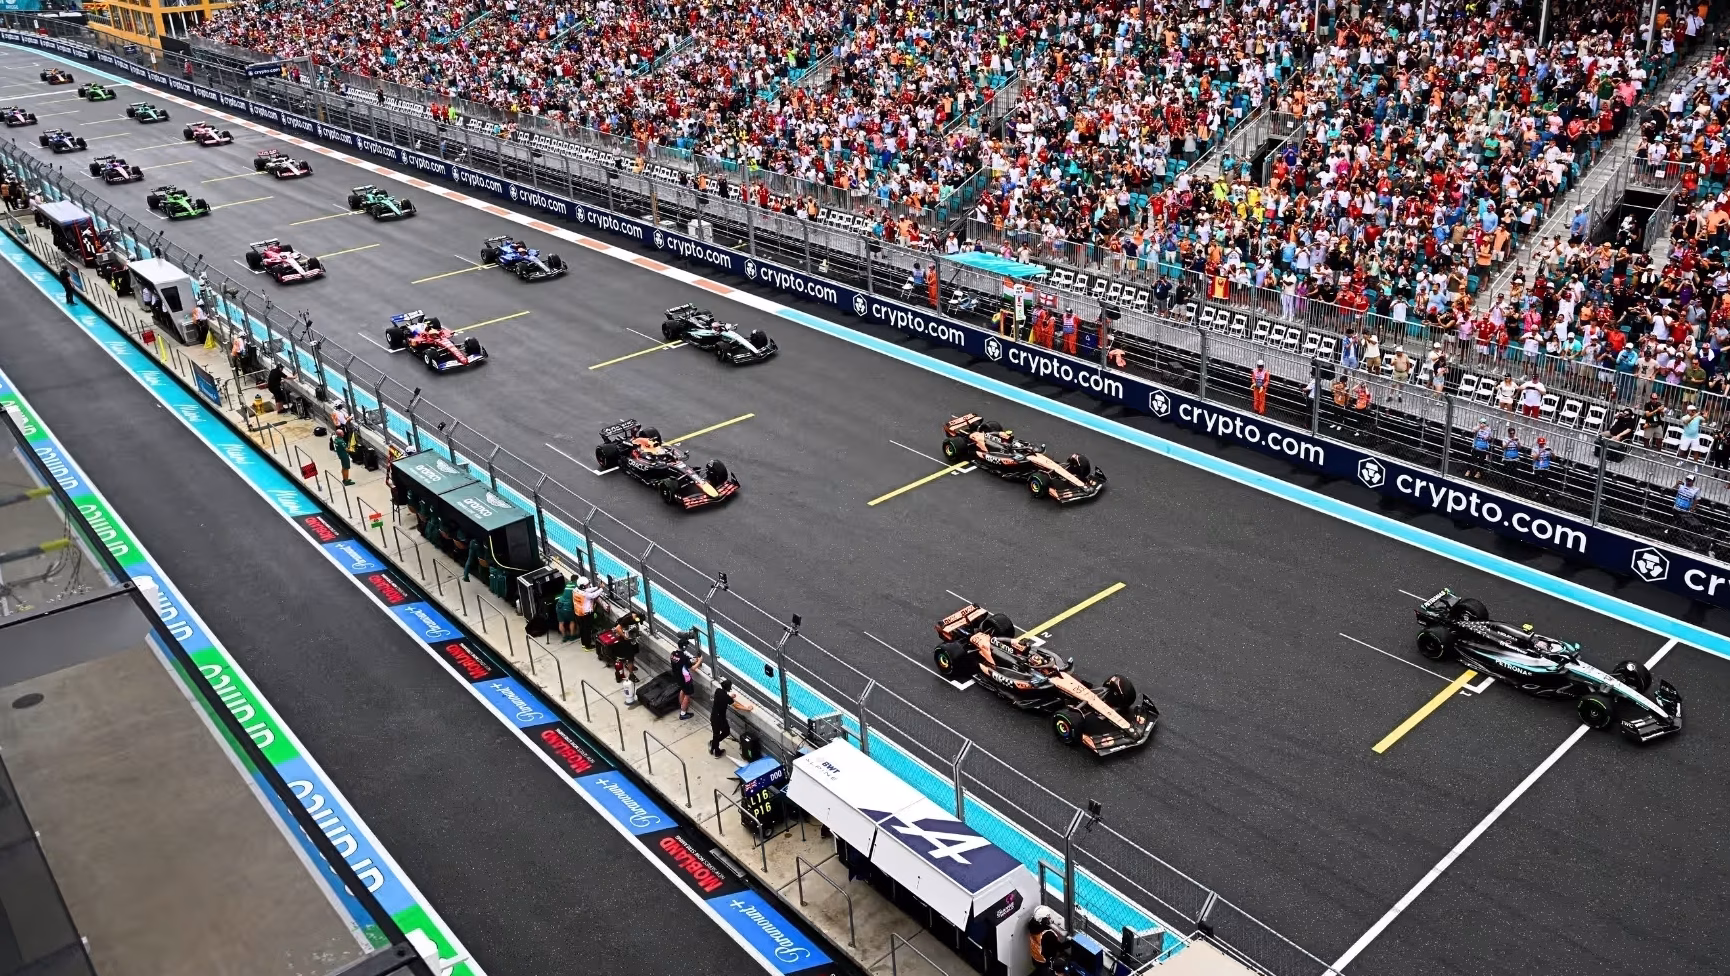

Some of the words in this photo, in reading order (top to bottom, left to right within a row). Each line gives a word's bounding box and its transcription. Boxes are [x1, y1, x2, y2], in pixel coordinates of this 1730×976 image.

[253, 106, 279, 120] crypto.com
[286, 116, 314, 132] crypto.com
[322, 128, 353, 145] crypto.com
[363, 141, 397, 159] crypto.com
[408, 155, 446, 175] crypto.com
[460, 171, 503, 194] crypto.com
[519, 190, 567, 215] crypto.com
[587, 211, 643, 240] crypto.com
[667, 236, 732, 269] crypto.com
[760, 266, 837, 304] crypto.com
[872, 303, 965, 347] crypto.com
[1008, 347, 1124, 400] crypto.com
[1178, 402, 1325, 466] crypto.com
[415, 464, 442, 482] aramco
[628, 458, 650, 472] ORACLE
[463, 498, 493, 517] aramco
[1396, 473, 1587, 554] crypto.com
[1684, 568, 1730, 596] cr
[1423, 589, 1446, 608] PETRONAS
[990, 636, 1014, 654] chrome
[490, 682, 544, 723] Paramount+
[1621, 719, 1634, 729] IWC
[540, 729, 593, 774] MOBLAND
[821, 761, 841, 774] BWT
[595, 777, 661, 828] Paramount+
[750, 789, 769, 806] L16
[753, 801, 772, 818] P16
[659, 836, 724, 893] MOBLAND
[729, 899, 811, 964] Paramount+
